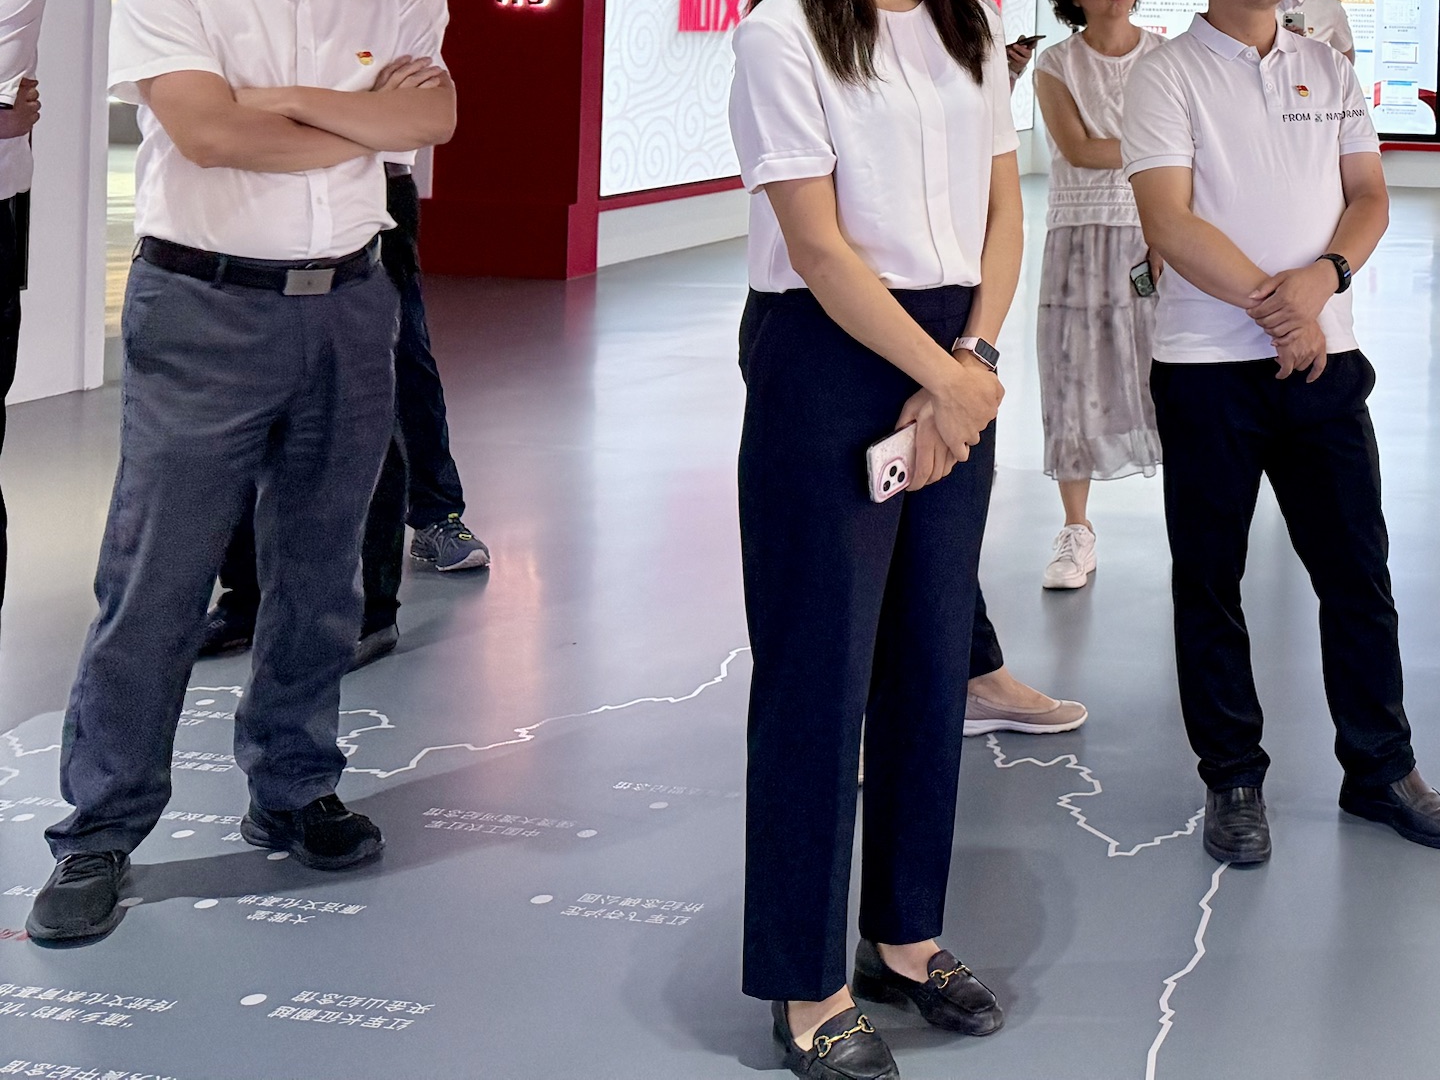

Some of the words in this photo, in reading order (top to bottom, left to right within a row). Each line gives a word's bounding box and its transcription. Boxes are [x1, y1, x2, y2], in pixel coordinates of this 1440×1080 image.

[1282, 112, 1311, 122] FROM
[560, 904, 692, 926] 红军飞夺泸定
[290, 990, 436, 1015] 夹金山纪念馆
[266, 1005, 415, 1031] 红军长征翻越
